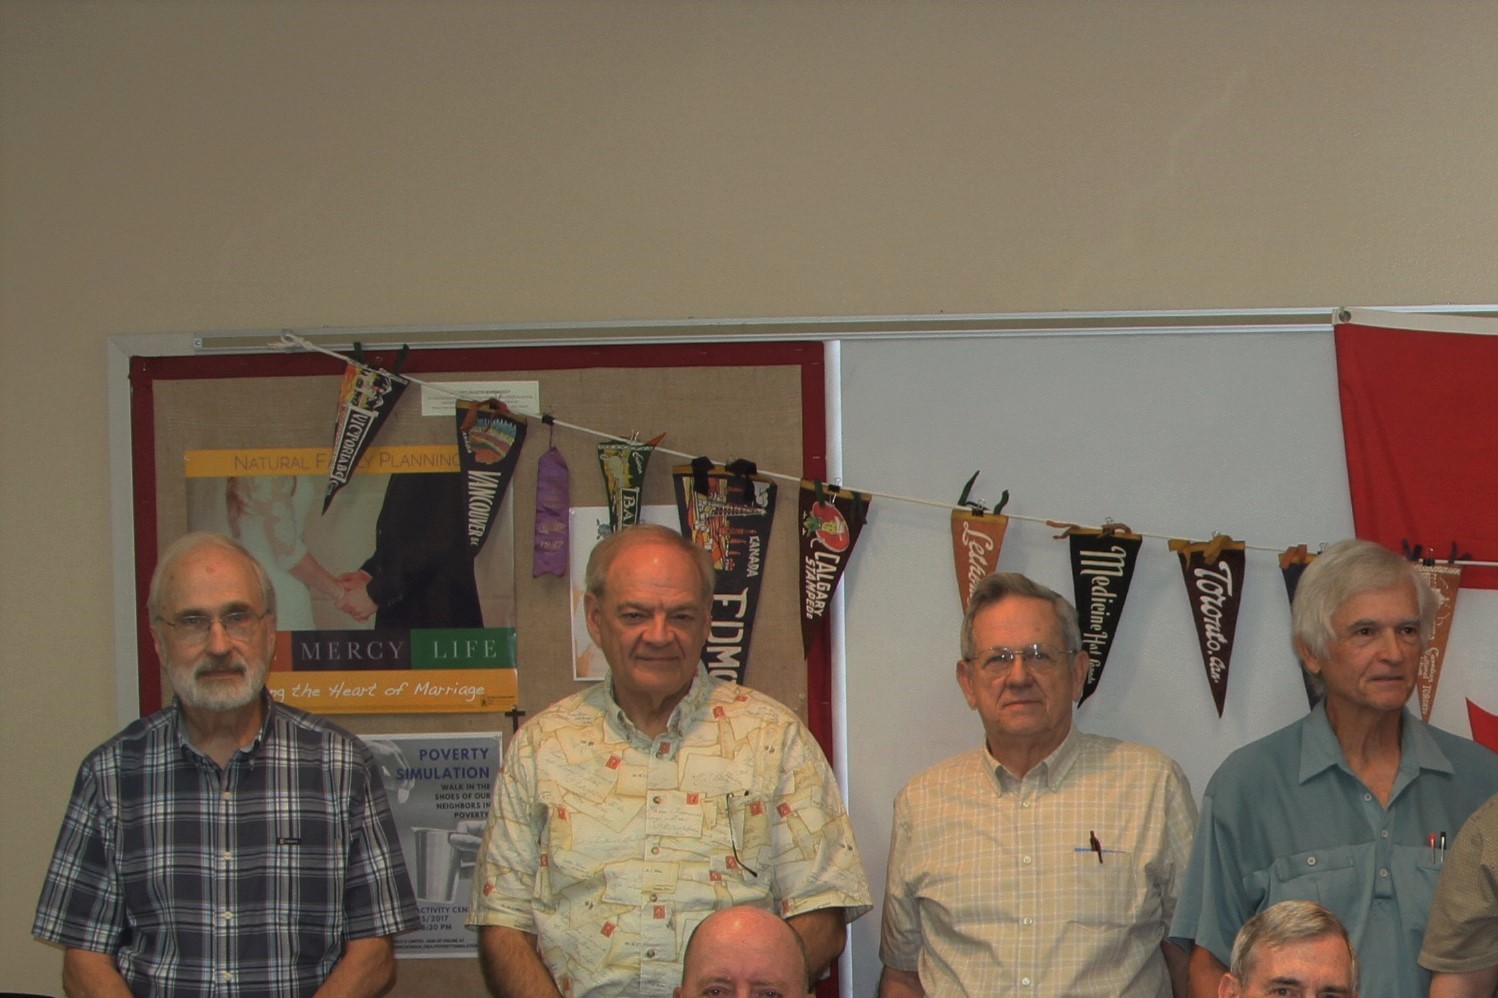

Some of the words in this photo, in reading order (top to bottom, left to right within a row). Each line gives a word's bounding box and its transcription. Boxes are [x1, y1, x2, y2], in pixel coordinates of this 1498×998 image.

[337, 413, 368, 463] VICTORIA
[234, 453, 311, 471] NATURAL
[467, 470, 502, 538] VANCOUVER
[746, 535, 760, 577] CANADA
[813, 551, 841, 617] CALGARY
[1079, 544, 1127, 631] Medicine
[300, 640, 406, 662] MERCY
[432, 639, 498, 660] LIFE
[1082, 631, 1109, 656] Hat
[291, 682, 321, 698] the
[328, 681, 376, 698] Heart
[383, 681, 409, 697] of
[413, 680, 486, 702] Marriage
[418, 748, 490, 761] POVERTY
[395, 767, 490, 780] SIMULATION
[436, 802, 481, 810] NEIGHBORS
